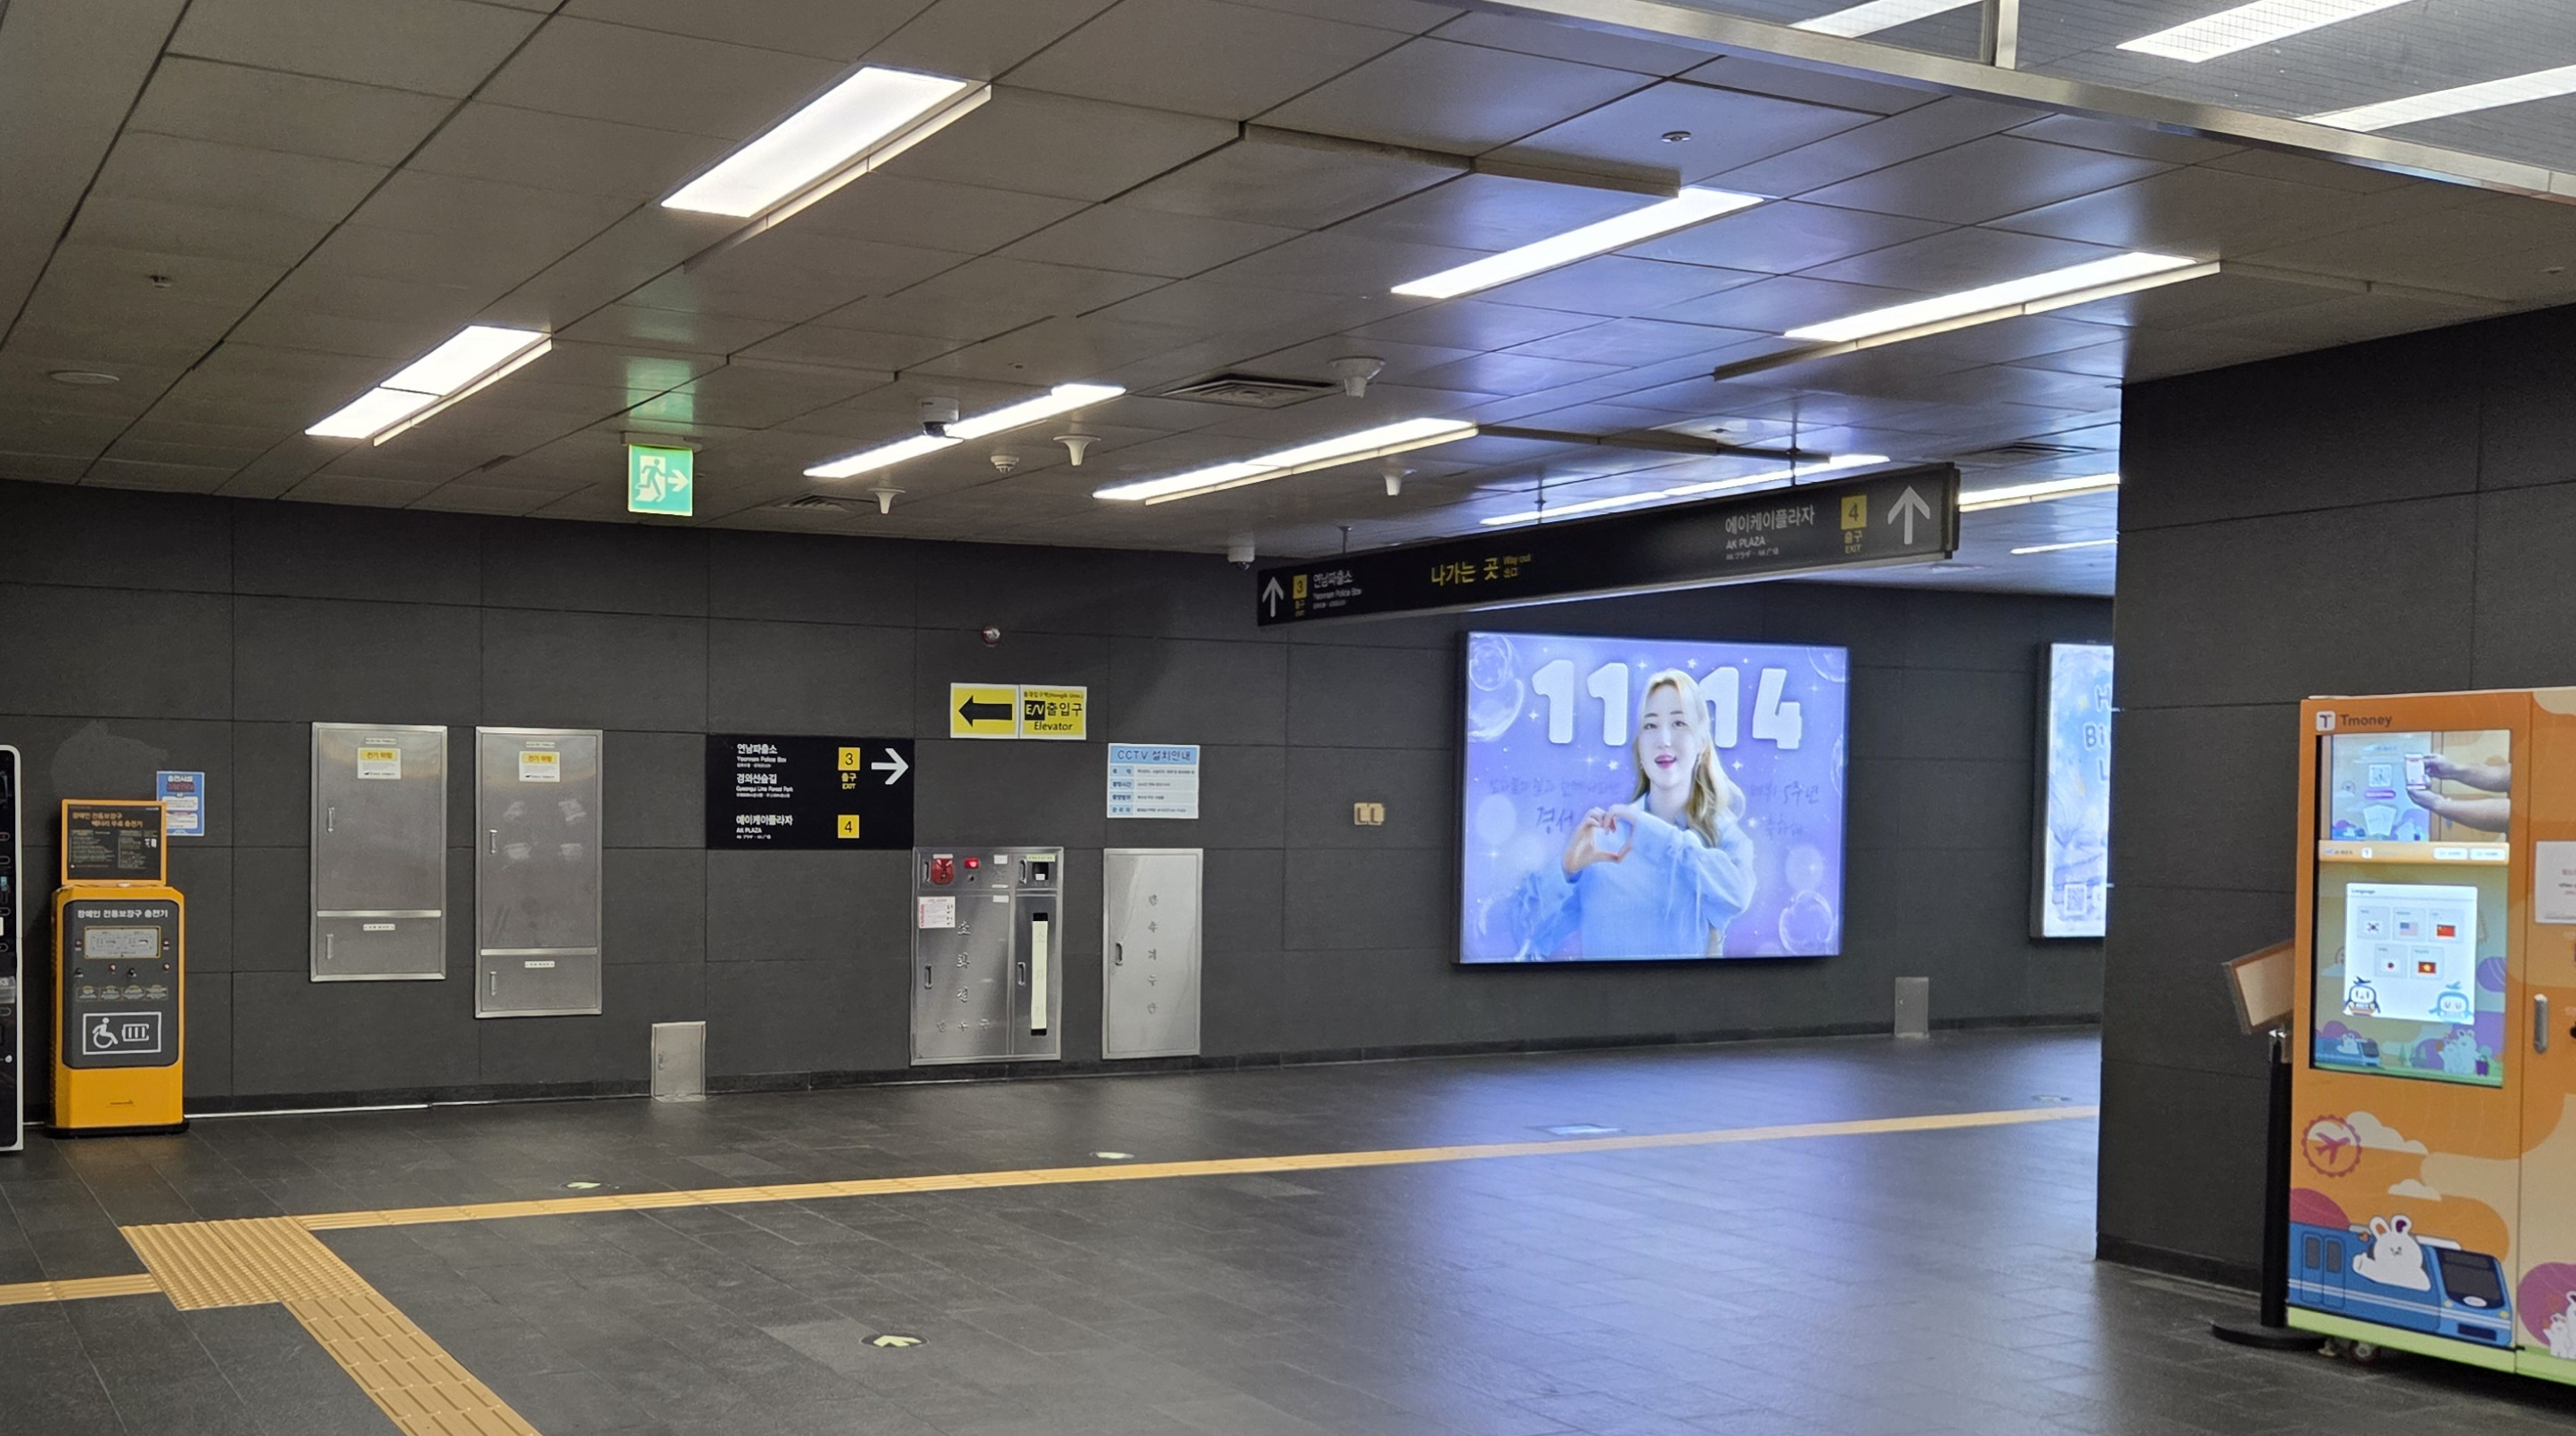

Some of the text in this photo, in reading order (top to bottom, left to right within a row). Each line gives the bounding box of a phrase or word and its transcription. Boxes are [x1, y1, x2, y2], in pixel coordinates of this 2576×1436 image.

[1848, 502, 1859, 521] 4
[1725, 504, 1815, 534] 에이케이플라자
[1726, 535, 1766, 550] AK PLAZA
[1844, 530, 1863, 544] 출구
[1844, 543, 1861, 554] EXIT
[1431, 557, 1499, 587] 나가는 곳
[1296, 580, 1304, 594] 3
[1026, 701, 1083, 717] E/V 출입구
[1034, 721, 1074, 731] Elevator
[2340, 714, 2392, 727] Tmoney
[737, 743, 778, 755] 연남파출소
[1117, 749, 1191, 762] CCTV 설치안내
[845, 752, 854, 766] 3
[736, 772, 778, 785] 경의선숲길
[844, 820, 854, 834] 4
[1536, 806, 1573, 835] 경서
